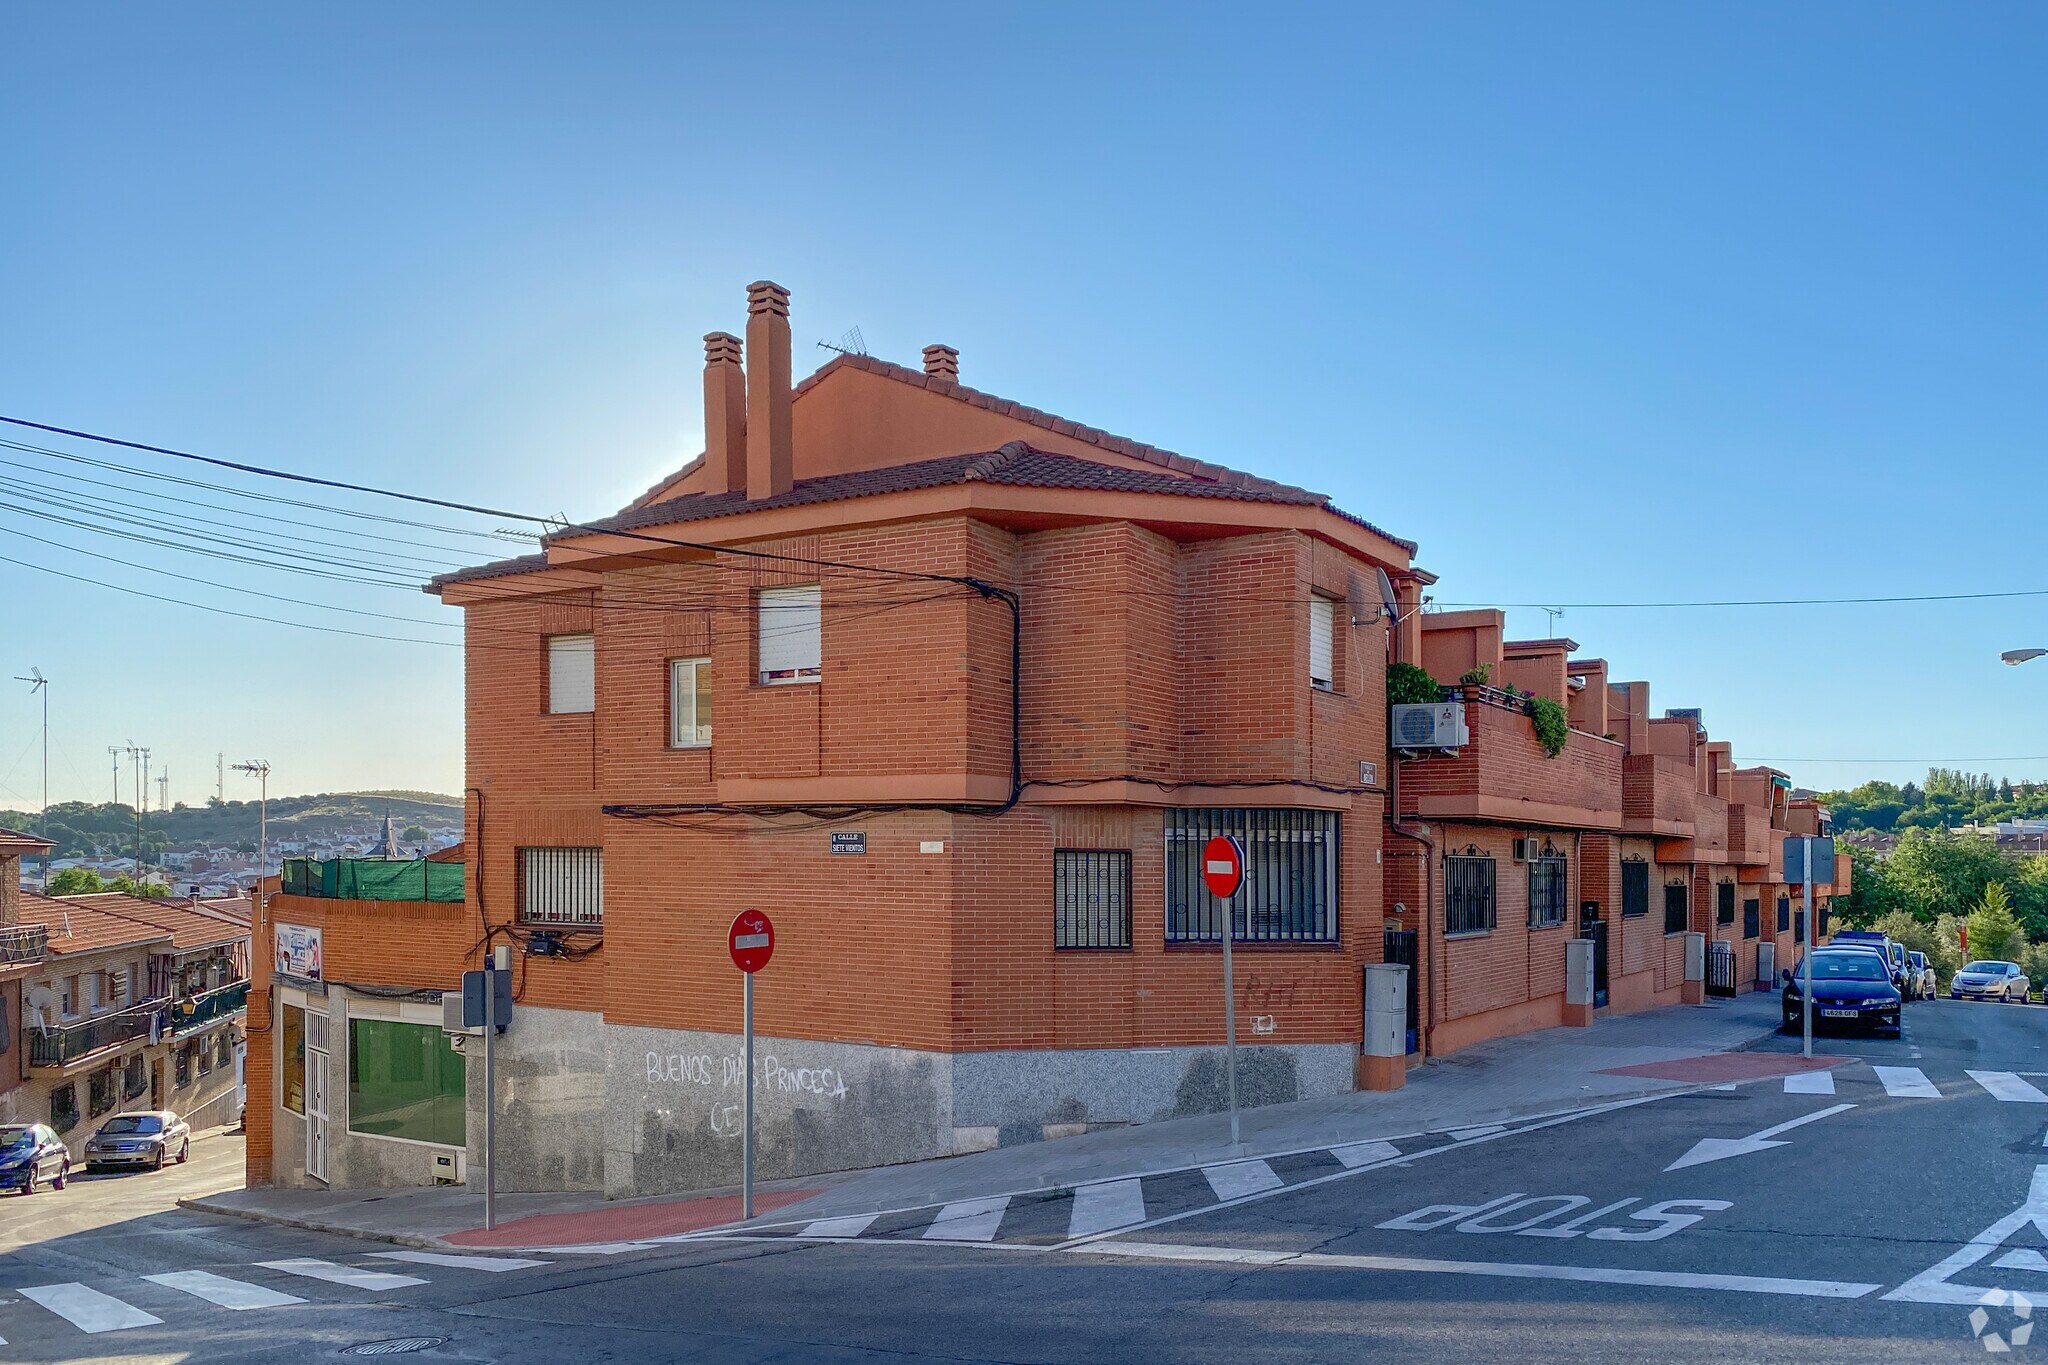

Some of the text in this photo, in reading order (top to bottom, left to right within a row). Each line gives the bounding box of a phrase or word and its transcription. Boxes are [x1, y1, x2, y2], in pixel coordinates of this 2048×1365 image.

[832, 844, 864, 852] SIETE VIENTOS
[646, 1051, 712, 1086] BUENOS
[765, 1056, 850, 1100] PRINCESA
[1374, 1192, 1735, 1241] STOP
